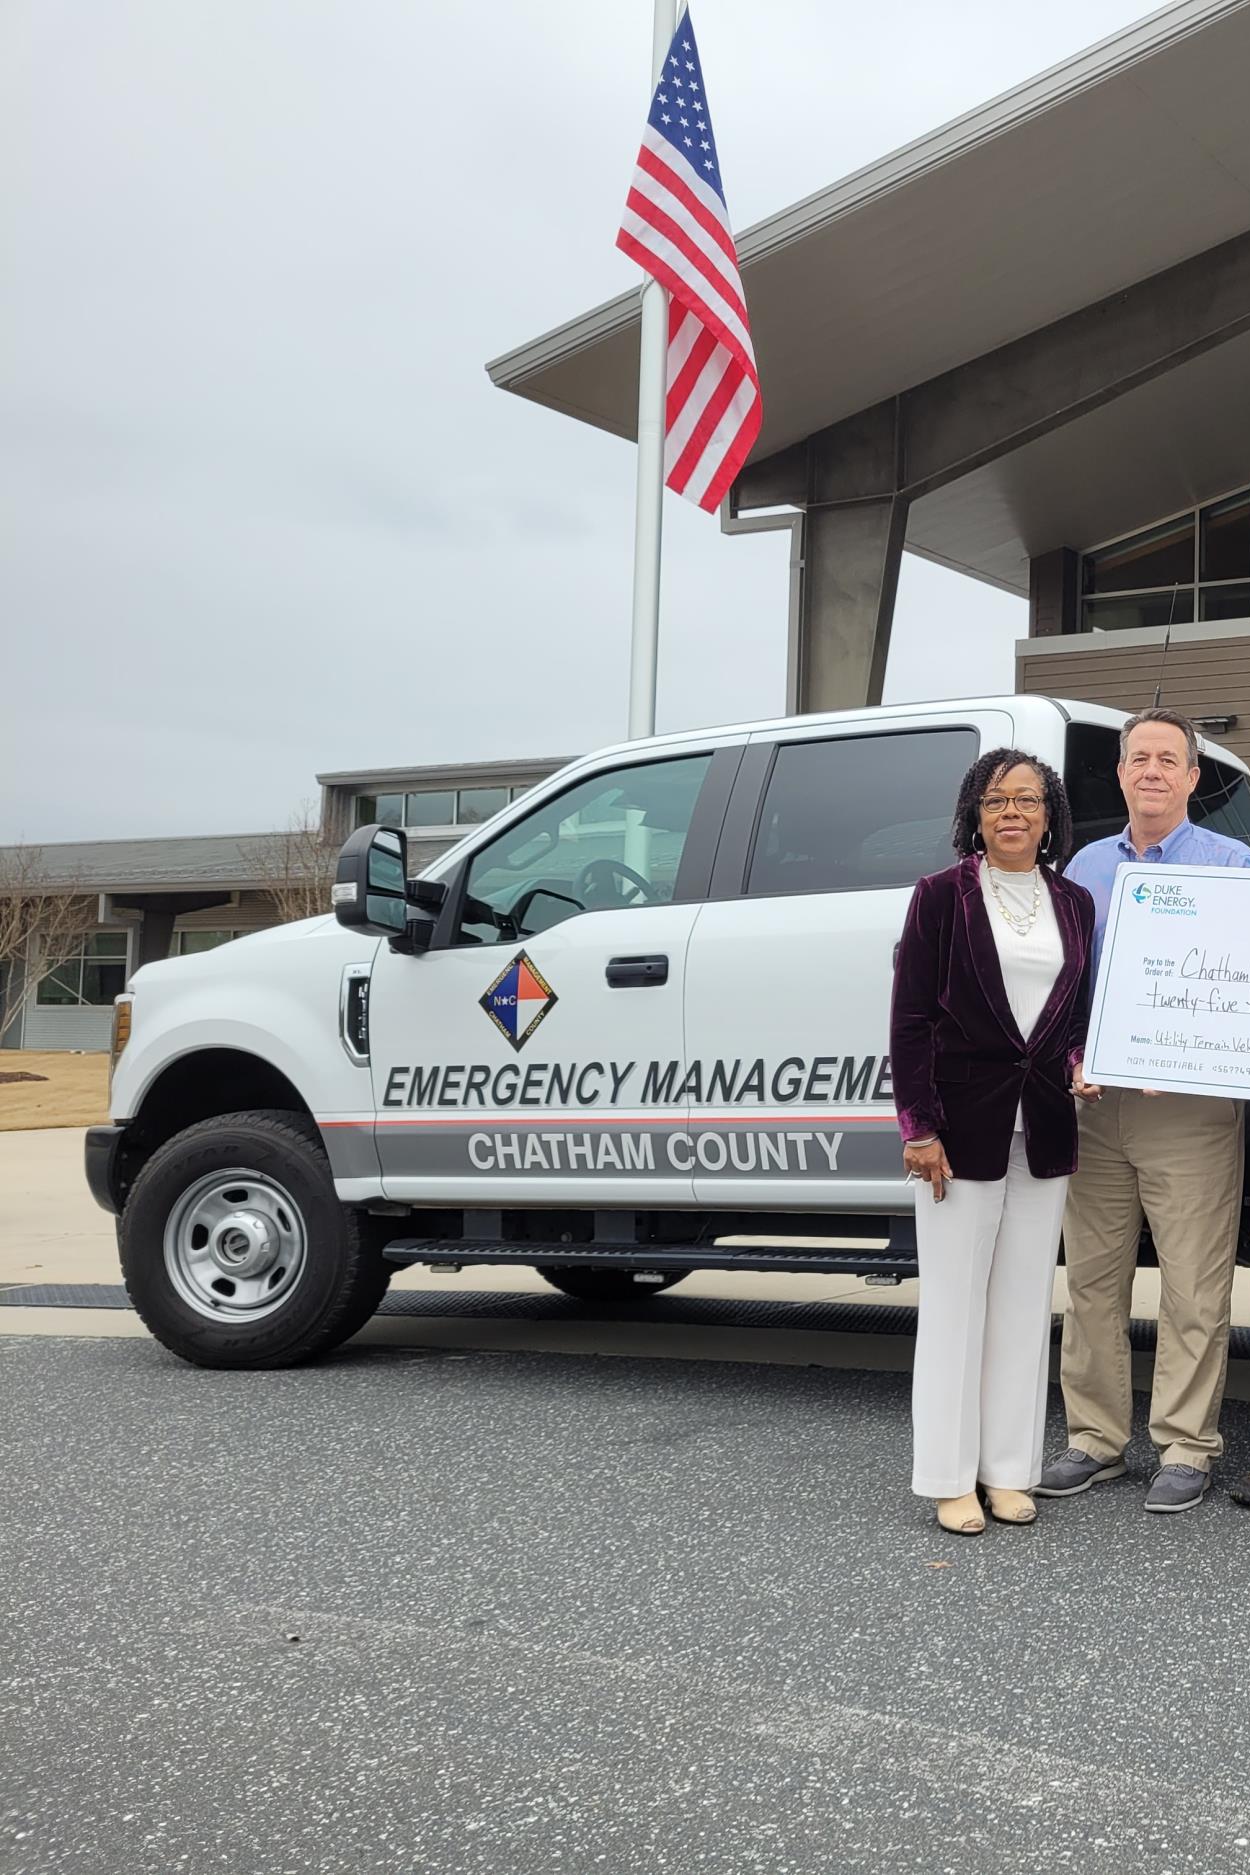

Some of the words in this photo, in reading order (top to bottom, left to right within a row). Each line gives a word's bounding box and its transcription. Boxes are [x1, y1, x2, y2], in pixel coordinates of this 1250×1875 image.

[1154, 884, 1182, 895] DUKE
[1151, 907, 1197, 917] FOUNDATION
[1143, 957, 1156, 967] Pay
[1156, 958, 1163, 966] to
[1164, 958, 1175, 967] the
[1144, 967, 1164, 977] Order
[1165, 968, 1174, 977] of:
[1180, 947, 1249, 983] Chatham
[486, 960, 516, 996] EMERGENCY
[523, 956, 552, 995] MANAGEMENT
[1146, 981, 1238, 1016] twenty-five
[488, 1010, 512, 1038] CHATHAM
[525, 1010, 545, 1036] COUNTY
[1130, 1035, 1153, 1045] Memo:
[1155, 1029, 1188, 1052] Utility
[1193, 1035, 1230, 1050] Terrain
[1126, 1056, 1145, 1065] NON
[1149, 1058, 1203, 1071] NEGOTIABLE
[382, 1061, 637, 1107] EMERGENCY
[639, 1055, 895, 1105] MANAGEME
[467, 1132, 656, 1170] CHATHAM
[666, 1131, 844, 1171] COUNTY
